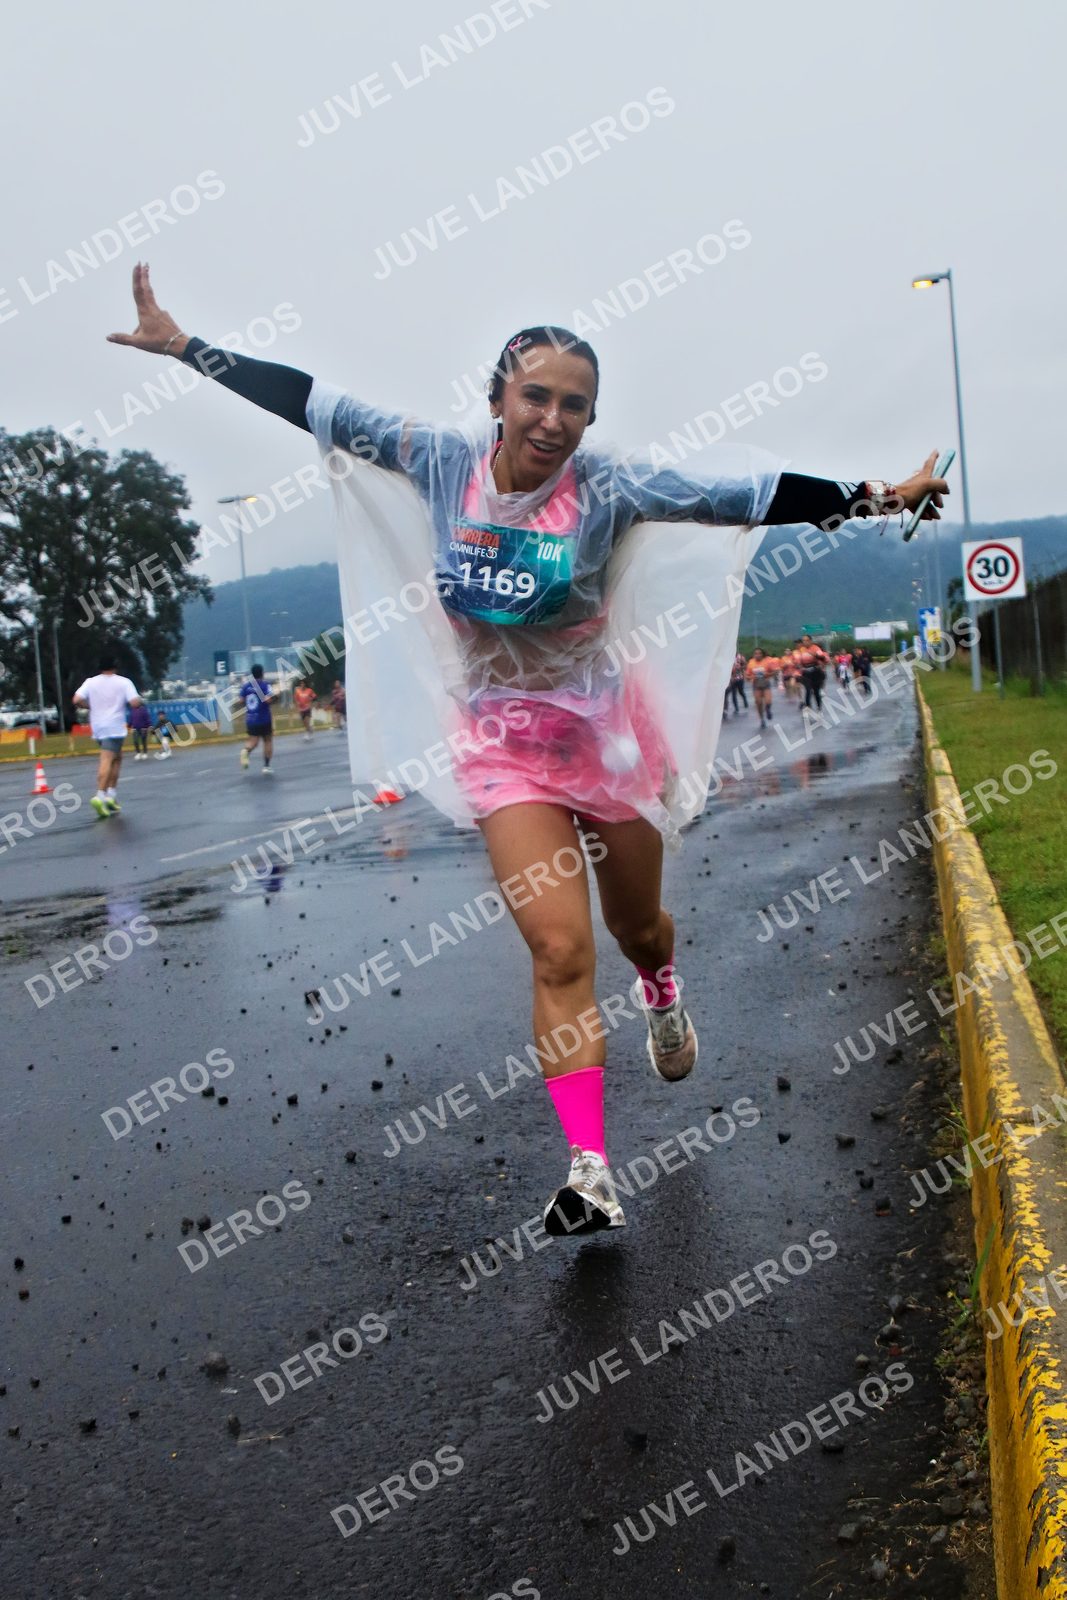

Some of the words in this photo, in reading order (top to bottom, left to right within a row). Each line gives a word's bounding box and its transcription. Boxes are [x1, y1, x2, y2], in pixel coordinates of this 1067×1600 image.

[449, 541, 486, 557] OMNILIFE
[536, 541, 564, 562] 10K
[976, 555, 1010, 579] 30
[459, 562, 536, 599] 1169
[217, 660, 226, 674] E
